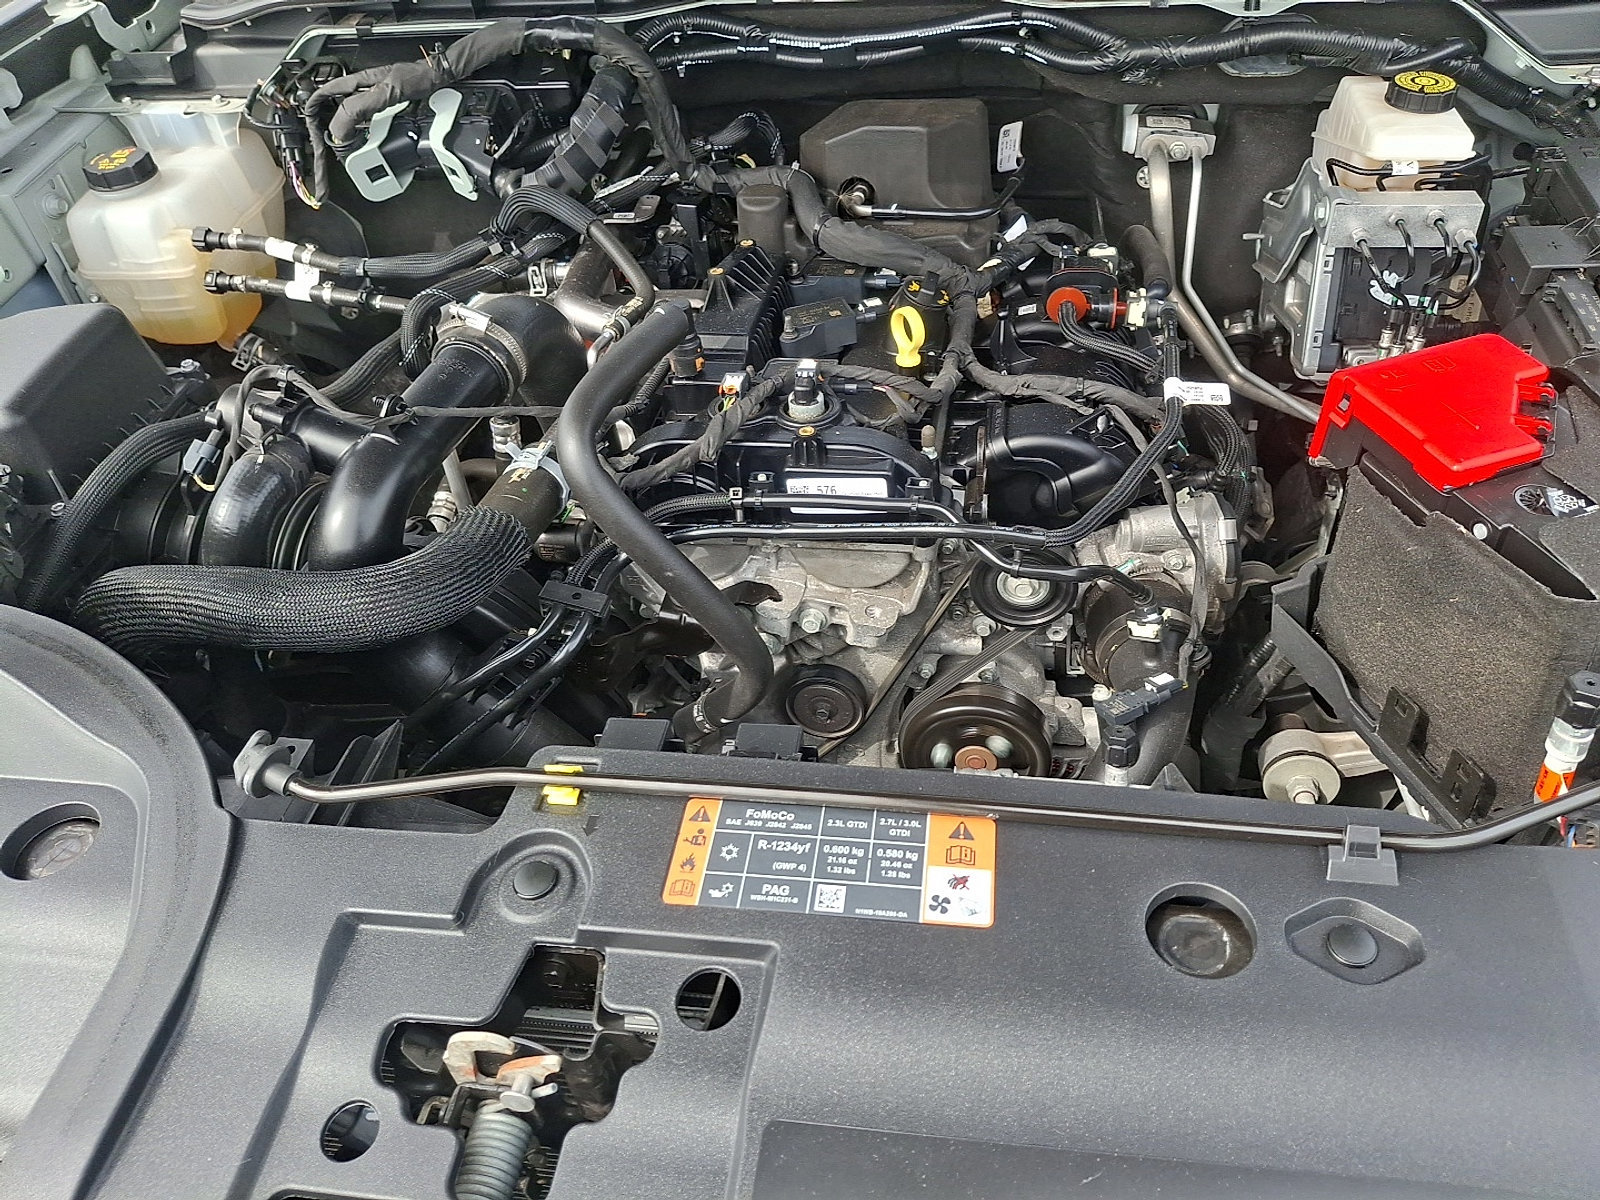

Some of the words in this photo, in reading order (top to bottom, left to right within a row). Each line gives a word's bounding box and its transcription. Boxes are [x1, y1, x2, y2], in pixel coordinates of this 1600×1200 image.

[817, 485, 837, 495] 576
[745, 808, 795, 821] FoMoCo
[726, 818, 743, 826] SAE
[827, 819, 845, 828] 2.3L
[880, 818, 898, 826] 2.7L
[903, 820, 922, 828] 3.0L
[757, 839, 811, 854] R-1234yf
[823, 845, 850, 855] 0.600
[851, 846, 865, 857] kg
[876, 848, 904, 859] 0.580
[905, 850, 919, 862] kg
[772, 861, 796, 871] (GWP
[797, 864, 807, 873] 4)
[880, 860, 902, 868] 20.46
[843, 867, 856, 875] lbs
[761, 883, 790, 896] PAG
